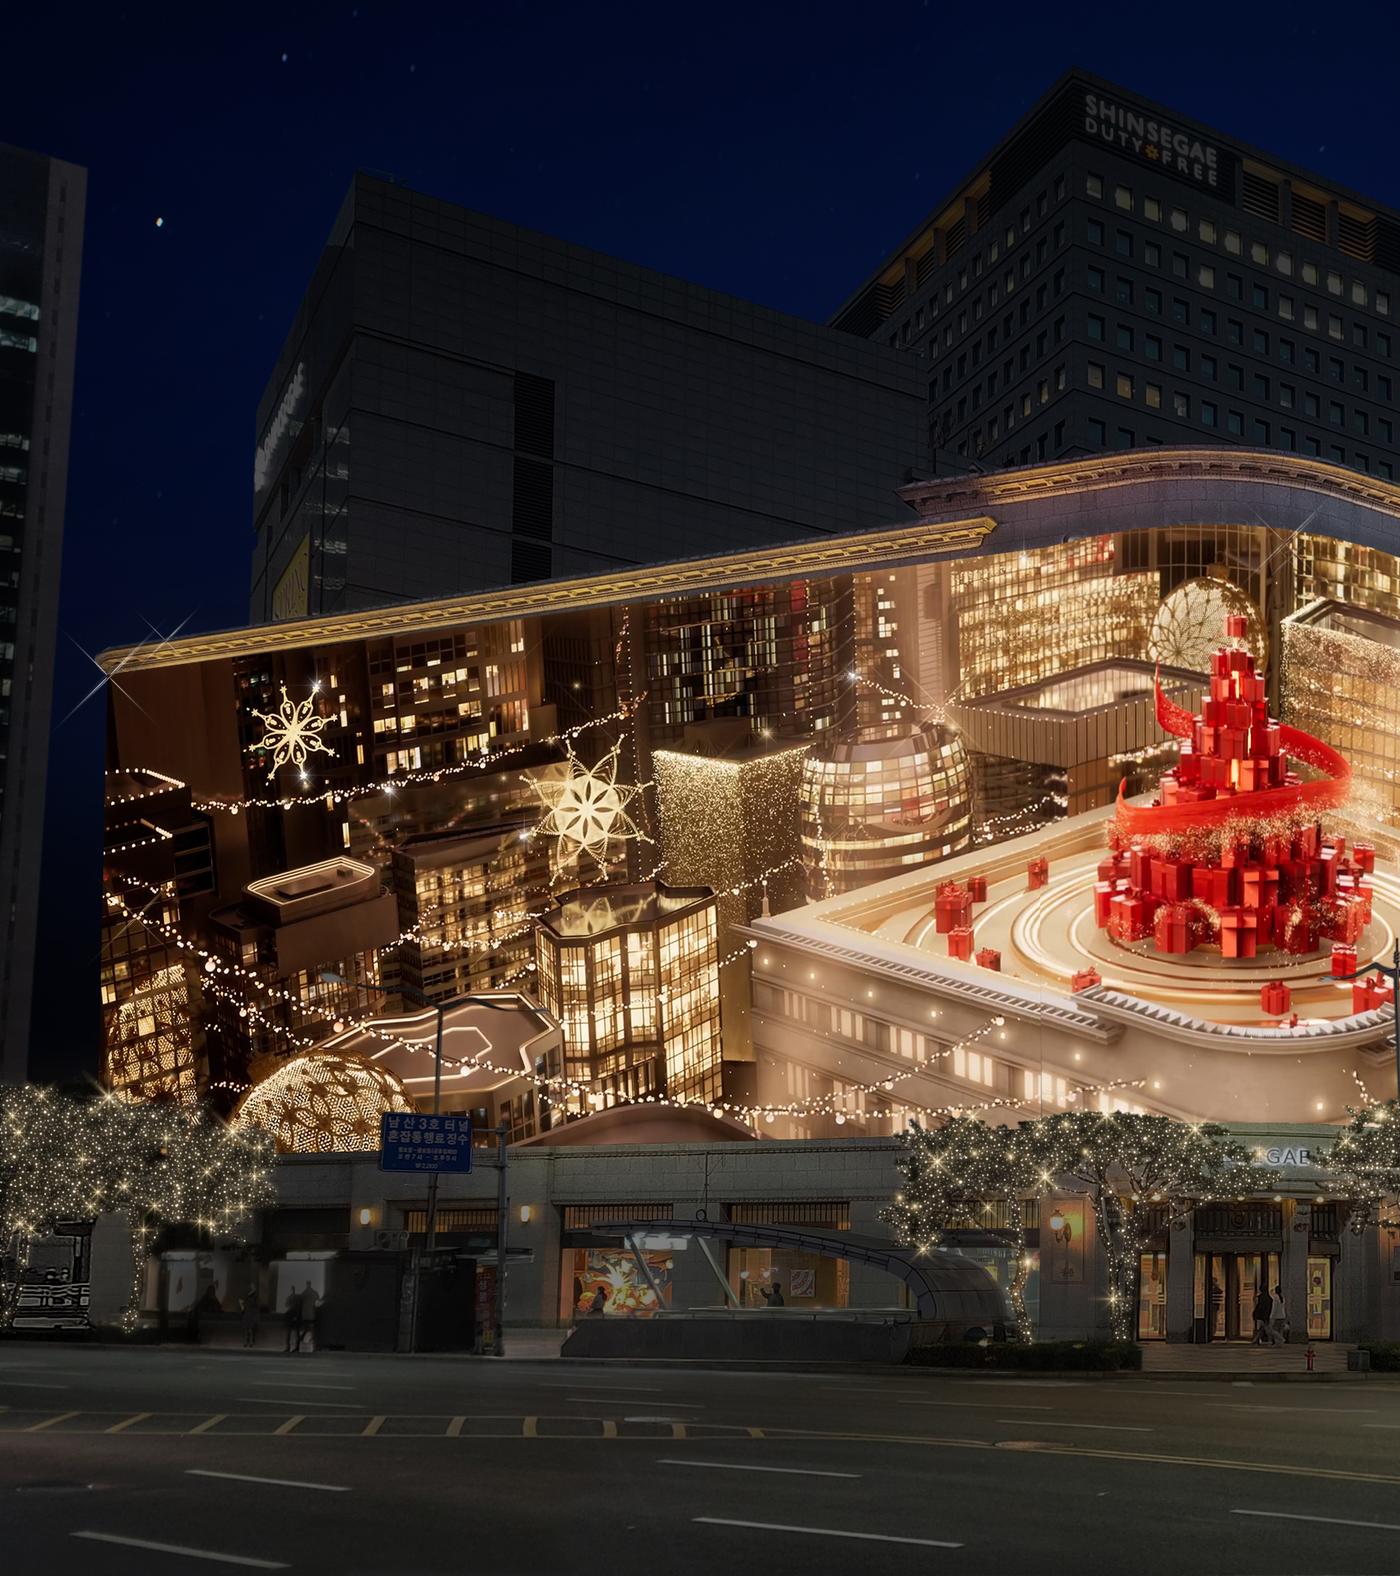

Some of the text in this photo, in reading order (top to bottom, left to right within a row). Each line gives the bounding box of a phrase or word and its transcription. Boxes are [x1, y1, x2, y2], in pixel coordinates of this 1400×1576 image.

[1085, 94, 1217, 169] SHINSEGAE
[1085, 117, 1217, 187] DUTY FREE
